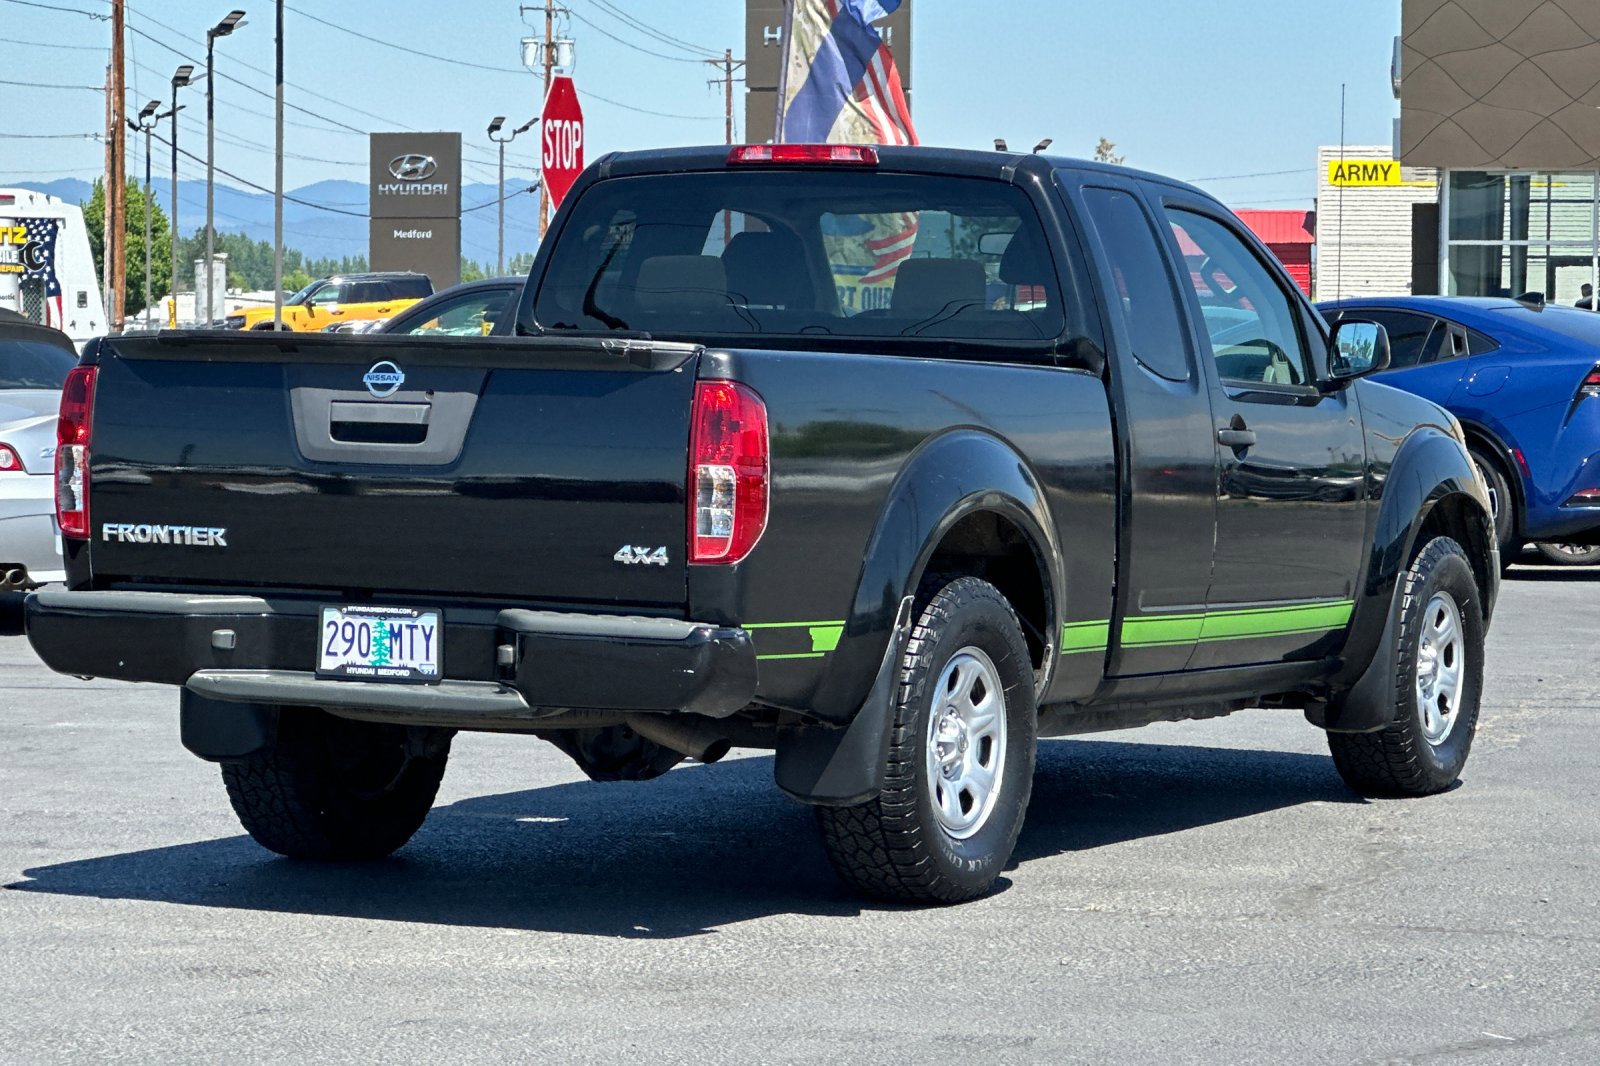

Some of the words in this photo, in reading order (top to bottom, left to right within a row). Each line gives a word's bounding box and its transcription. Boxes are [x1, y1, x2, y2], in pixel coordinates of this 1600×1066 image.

[544, 119, 581, 169] STOP
[1333, 164, 1393, 182] ARMY
[378, 184, 448, 195] HYUNDAI
[393, 230, 432, 239] Medford
[102, 523, 227, 546] FRONTIER
[325, 620, 371, 659] 290
[389, 623, 434, 661] MTY
[346, 667, 375, 675] HYUNDAI
[377, 668, 410, 677] MEDFORD
